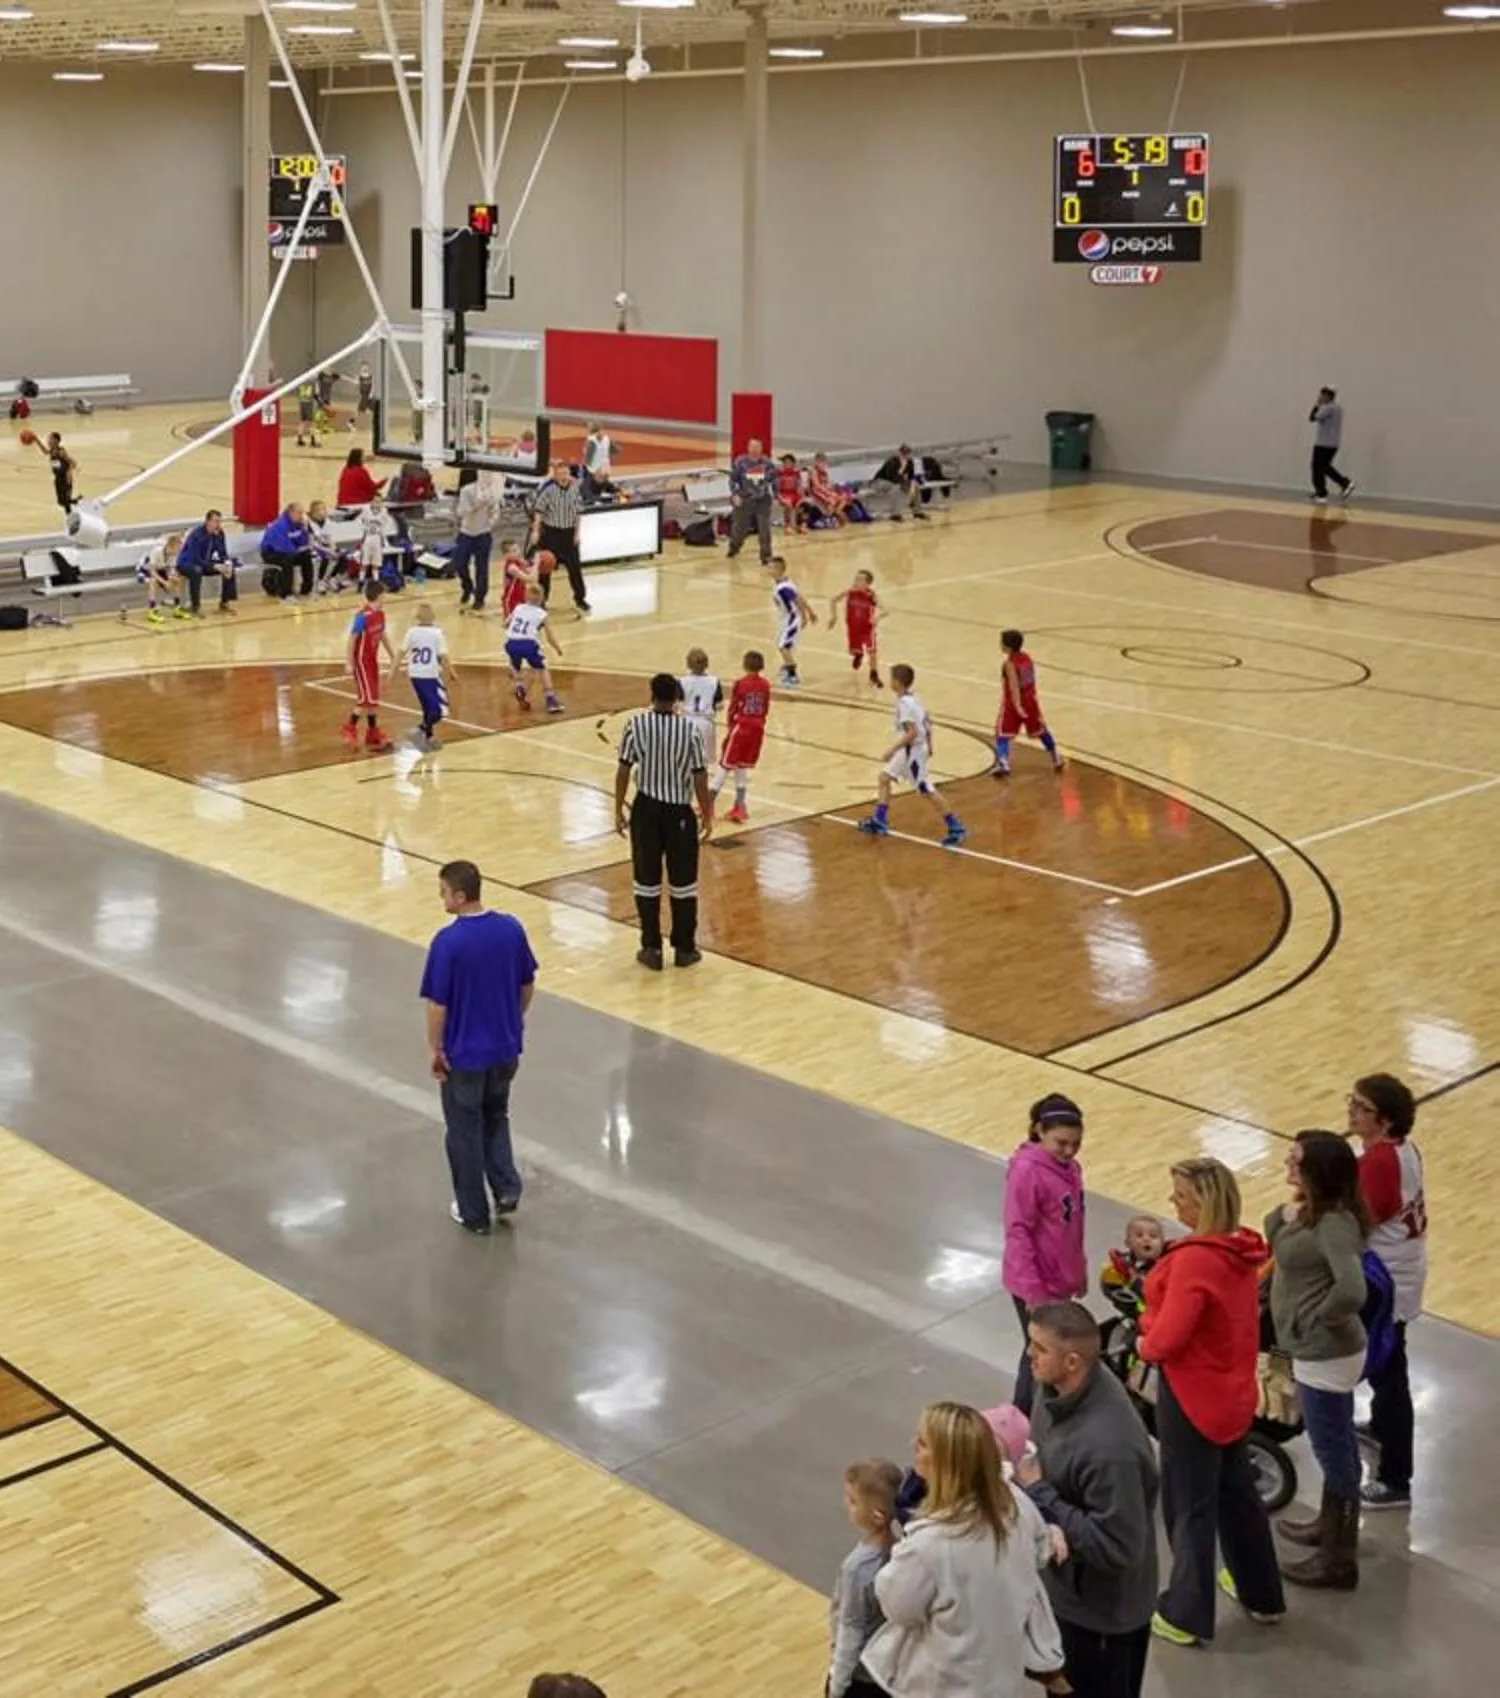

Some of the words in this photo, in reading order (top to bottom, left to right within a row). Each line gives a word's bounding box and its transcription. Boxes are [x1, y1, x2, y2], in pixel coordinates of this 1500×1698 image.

[1113, 136, 1166, 164] 5:19
[1078, 150, 1095, 176] 6
[1063, 196, 1081, 224] 0
[1187, 195, 1204, 223] 0
[285, 224, 327, 240] ppsi
[1111, 232, 1176, 255] pepsi
[1096, 267, 1141, 282] COURT
[1145, 266, 1159, 283] 7
[511, 617, 531, 635] 21
[411, 647, 432, 665] 20
